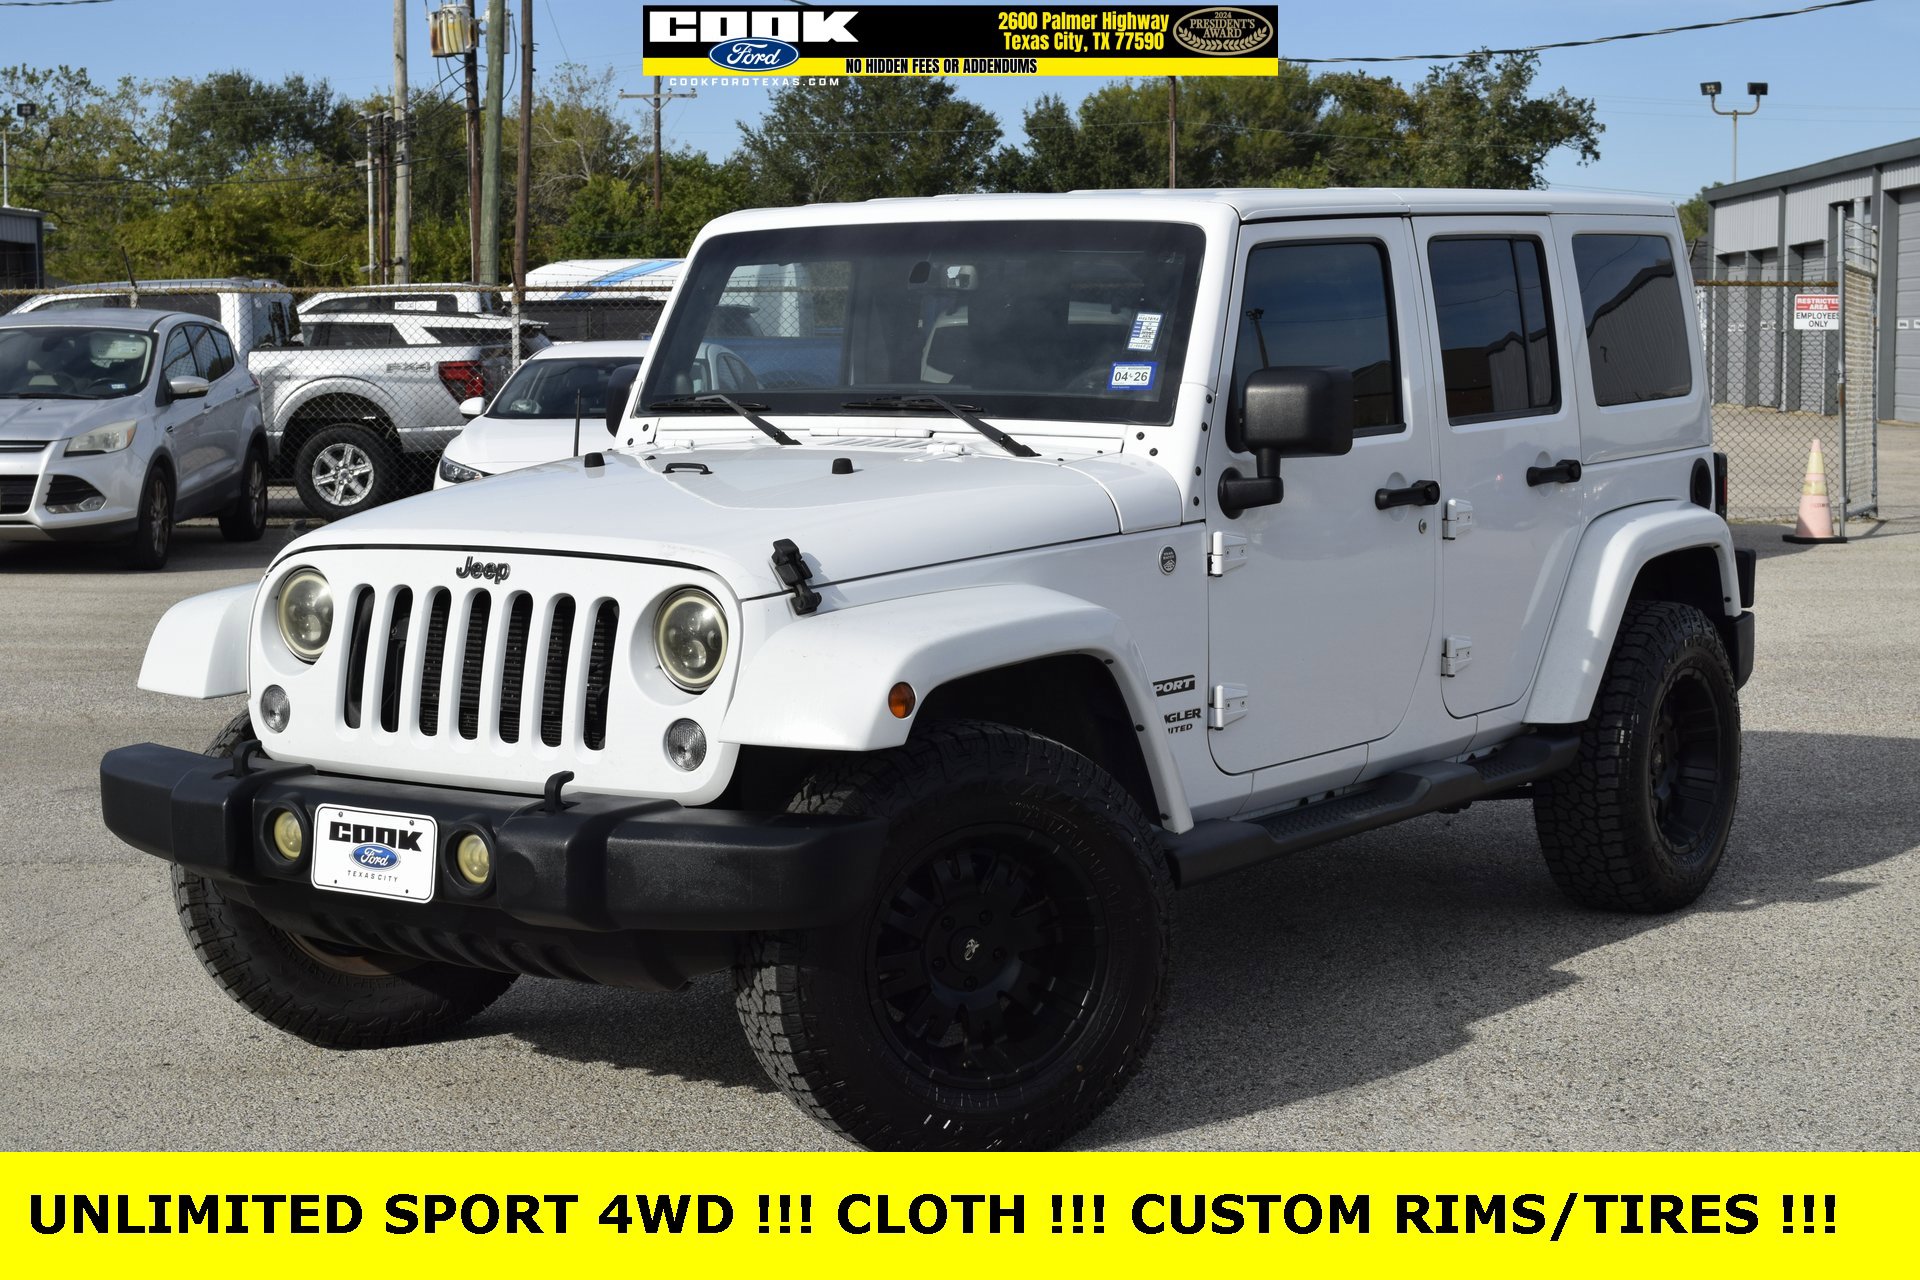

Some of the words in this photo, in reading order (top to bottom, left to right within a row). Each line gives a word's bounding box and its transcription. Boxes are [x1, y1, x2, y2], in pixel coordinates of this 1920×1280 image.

[1134, 371, 1148, 381] 26
[456, 556, 511, 585] Jeep
[329, 821, 423, 852] COOK
[360, 847, 389, 867] Ford
